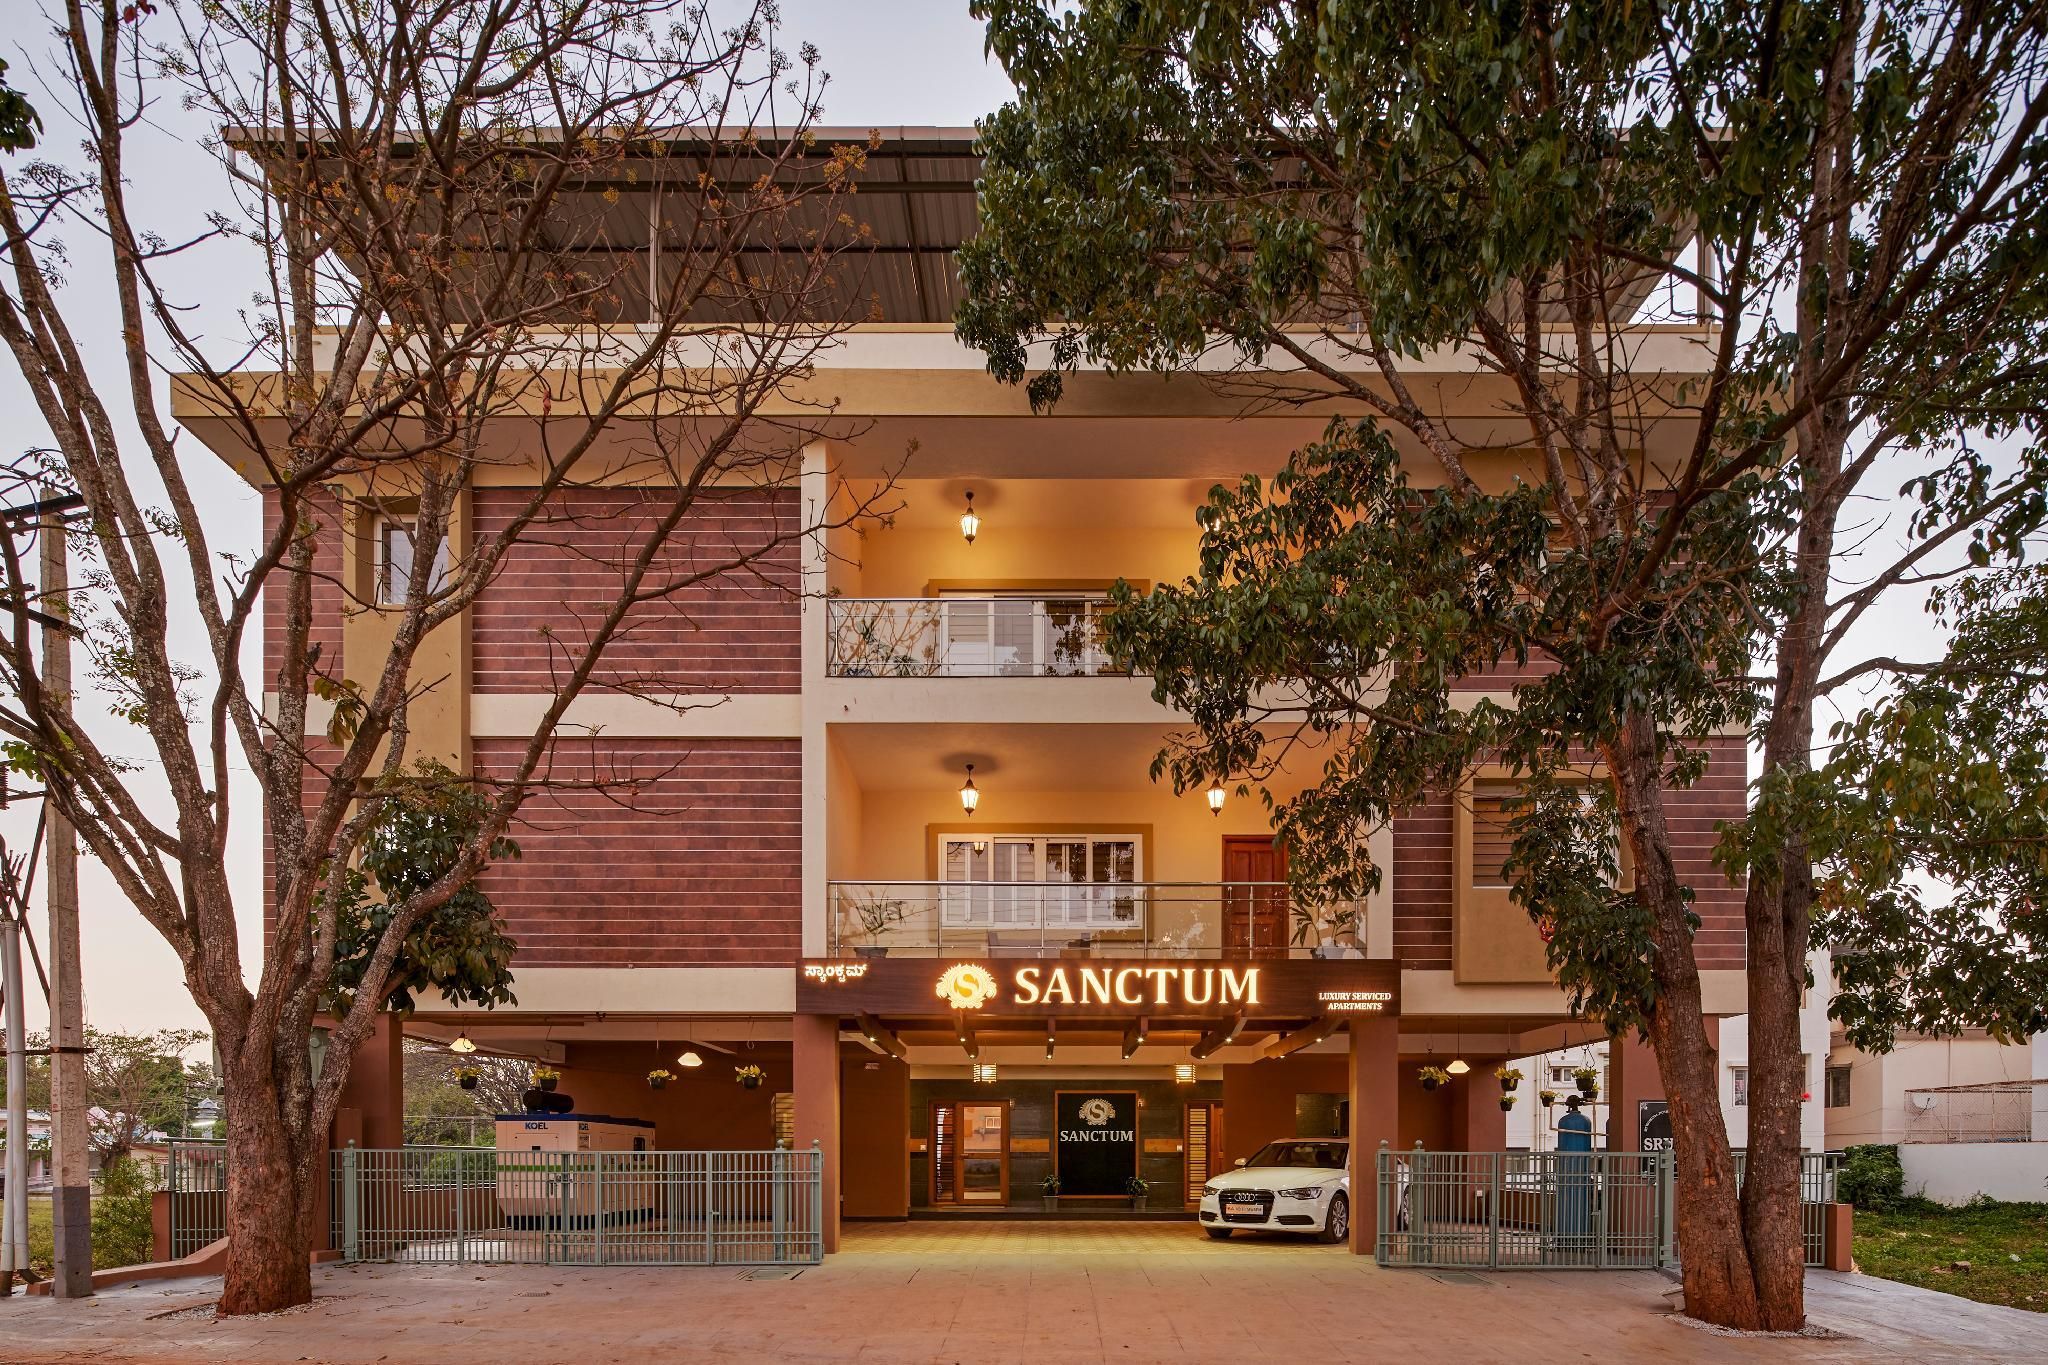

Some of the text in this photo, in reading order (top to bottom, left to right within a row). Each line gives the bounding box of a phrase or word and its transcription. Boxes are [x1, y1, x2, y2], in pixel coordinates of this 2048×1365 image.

[1013, 967, 1261, 1005] SANCTUM
[1318, 992, 1392, 1001] LUXURY SERVICED
[525, 1122, 548, 1130] KOEL
[1060, 1130, 1134, 1142] SANCTUM
